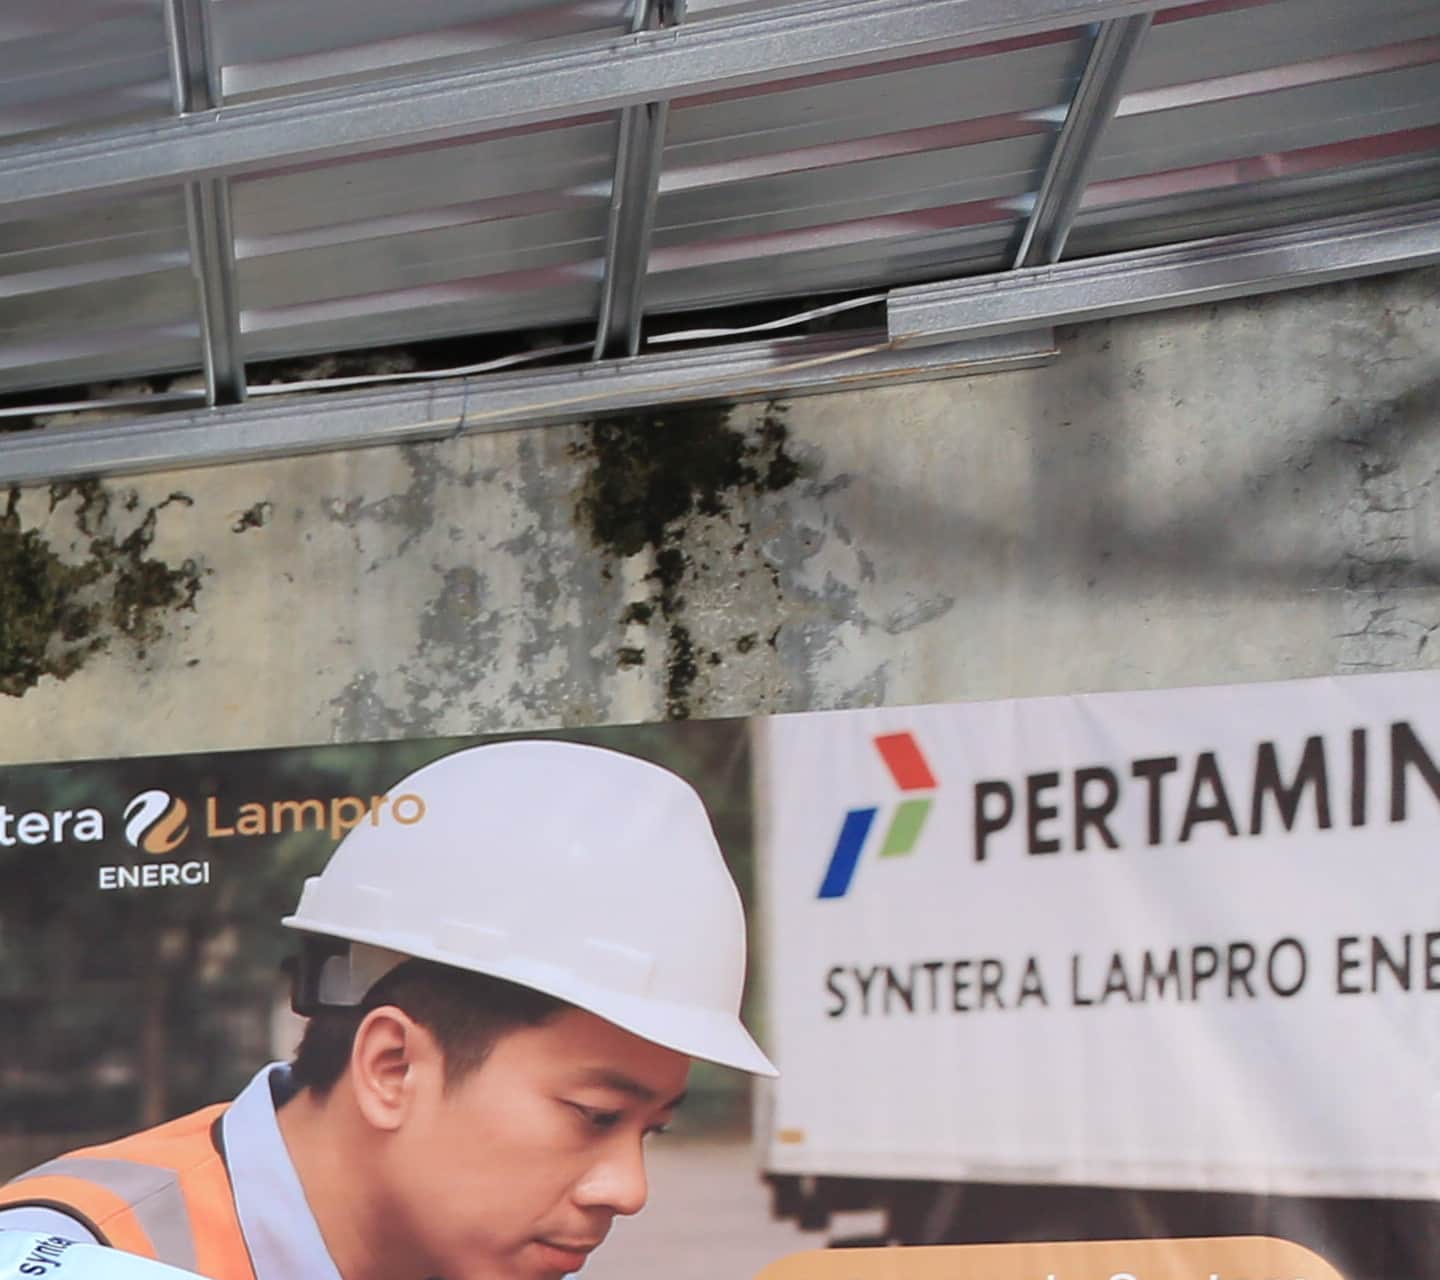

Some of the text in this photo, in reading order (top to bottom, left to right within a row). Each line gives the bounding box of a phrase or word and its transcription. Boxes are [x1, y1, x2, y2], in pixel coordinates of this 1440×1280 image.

[204, 793, 426, 843] Lampro
[97, 861, 210, 889] ENERGI
[824, 956, 1048, 1019] SYNTERA
[1071, 937, 1307, 1007] LAMPRO
